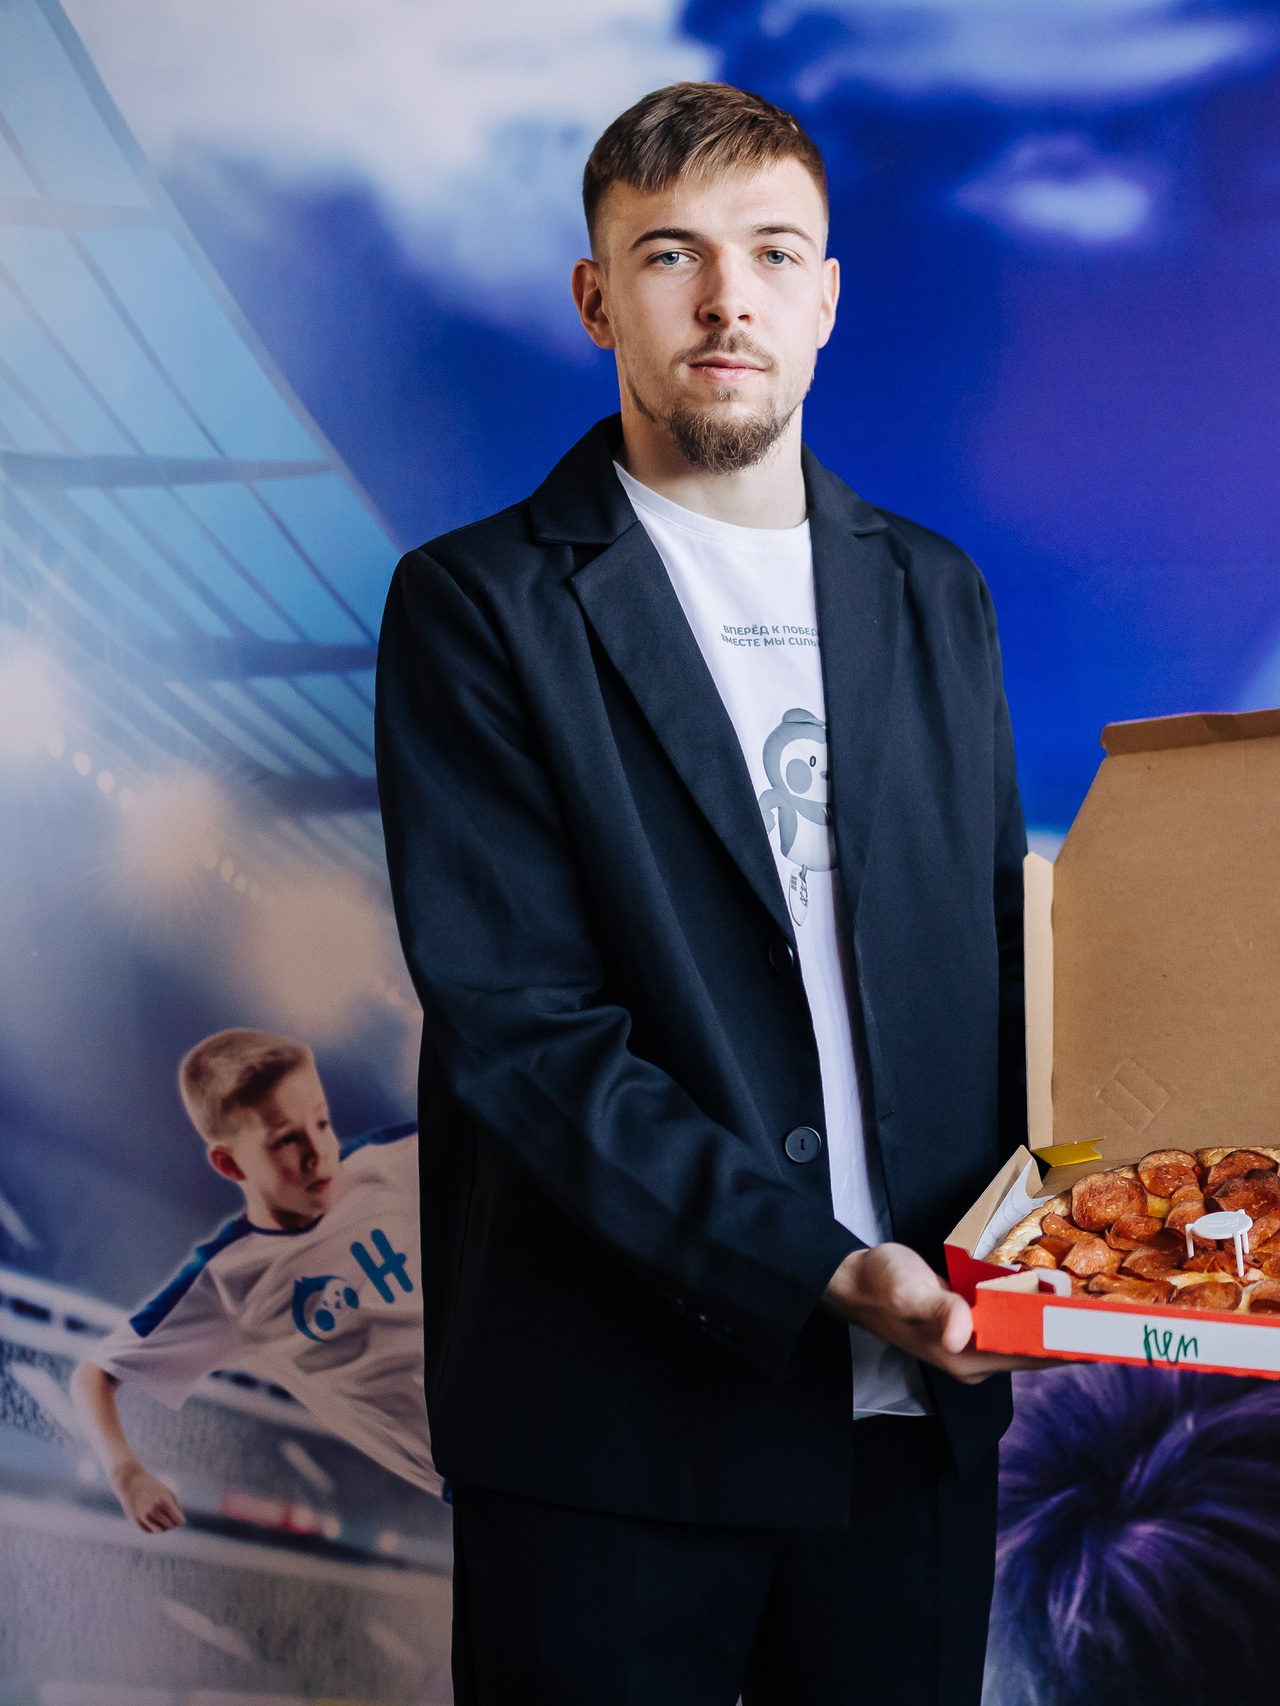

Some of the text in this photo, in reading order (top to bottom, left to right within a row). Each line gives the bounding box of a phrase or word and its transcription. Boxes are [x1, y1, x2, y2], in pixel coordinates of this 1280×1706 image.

[722, 624, 770, 636] ВПЕРЁД
[771, 625, 780, 634] К
[764, 637, 786, 647] МЫ
